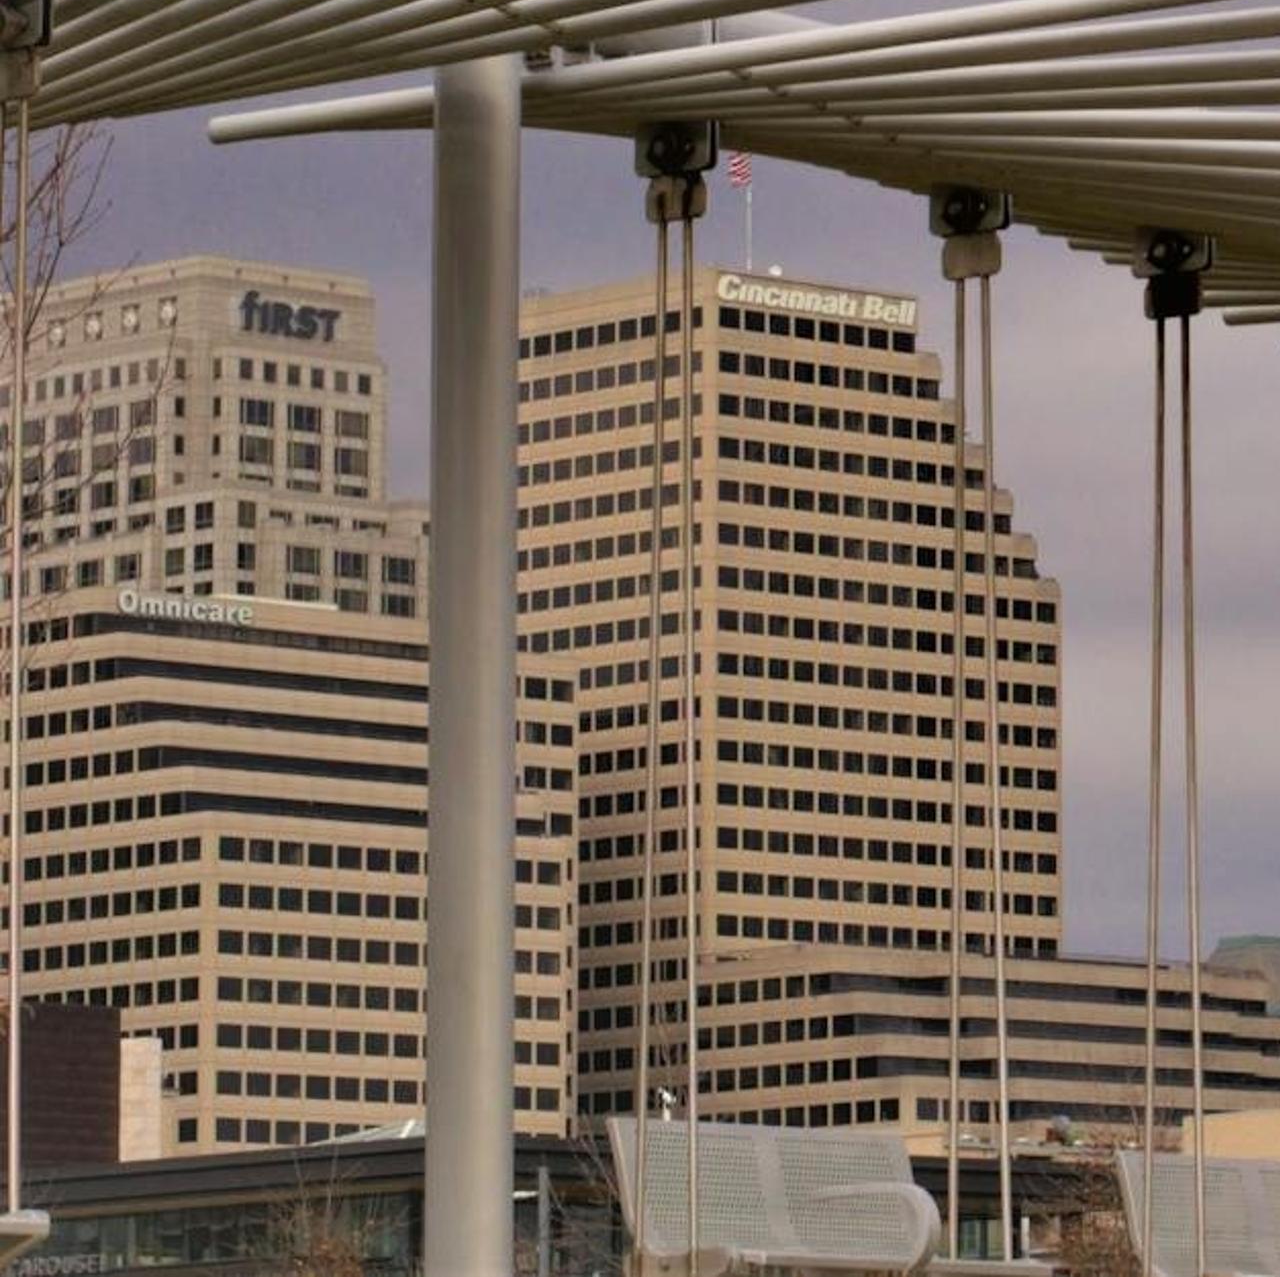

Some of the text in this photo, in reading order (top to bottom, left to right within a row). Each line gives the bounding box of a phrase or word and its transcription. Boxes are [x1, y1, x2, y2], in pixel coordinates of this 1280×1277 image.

[717, 274, 916, 325] Cincinnati Bell
[118, 589, 253, 624] Omnicare
